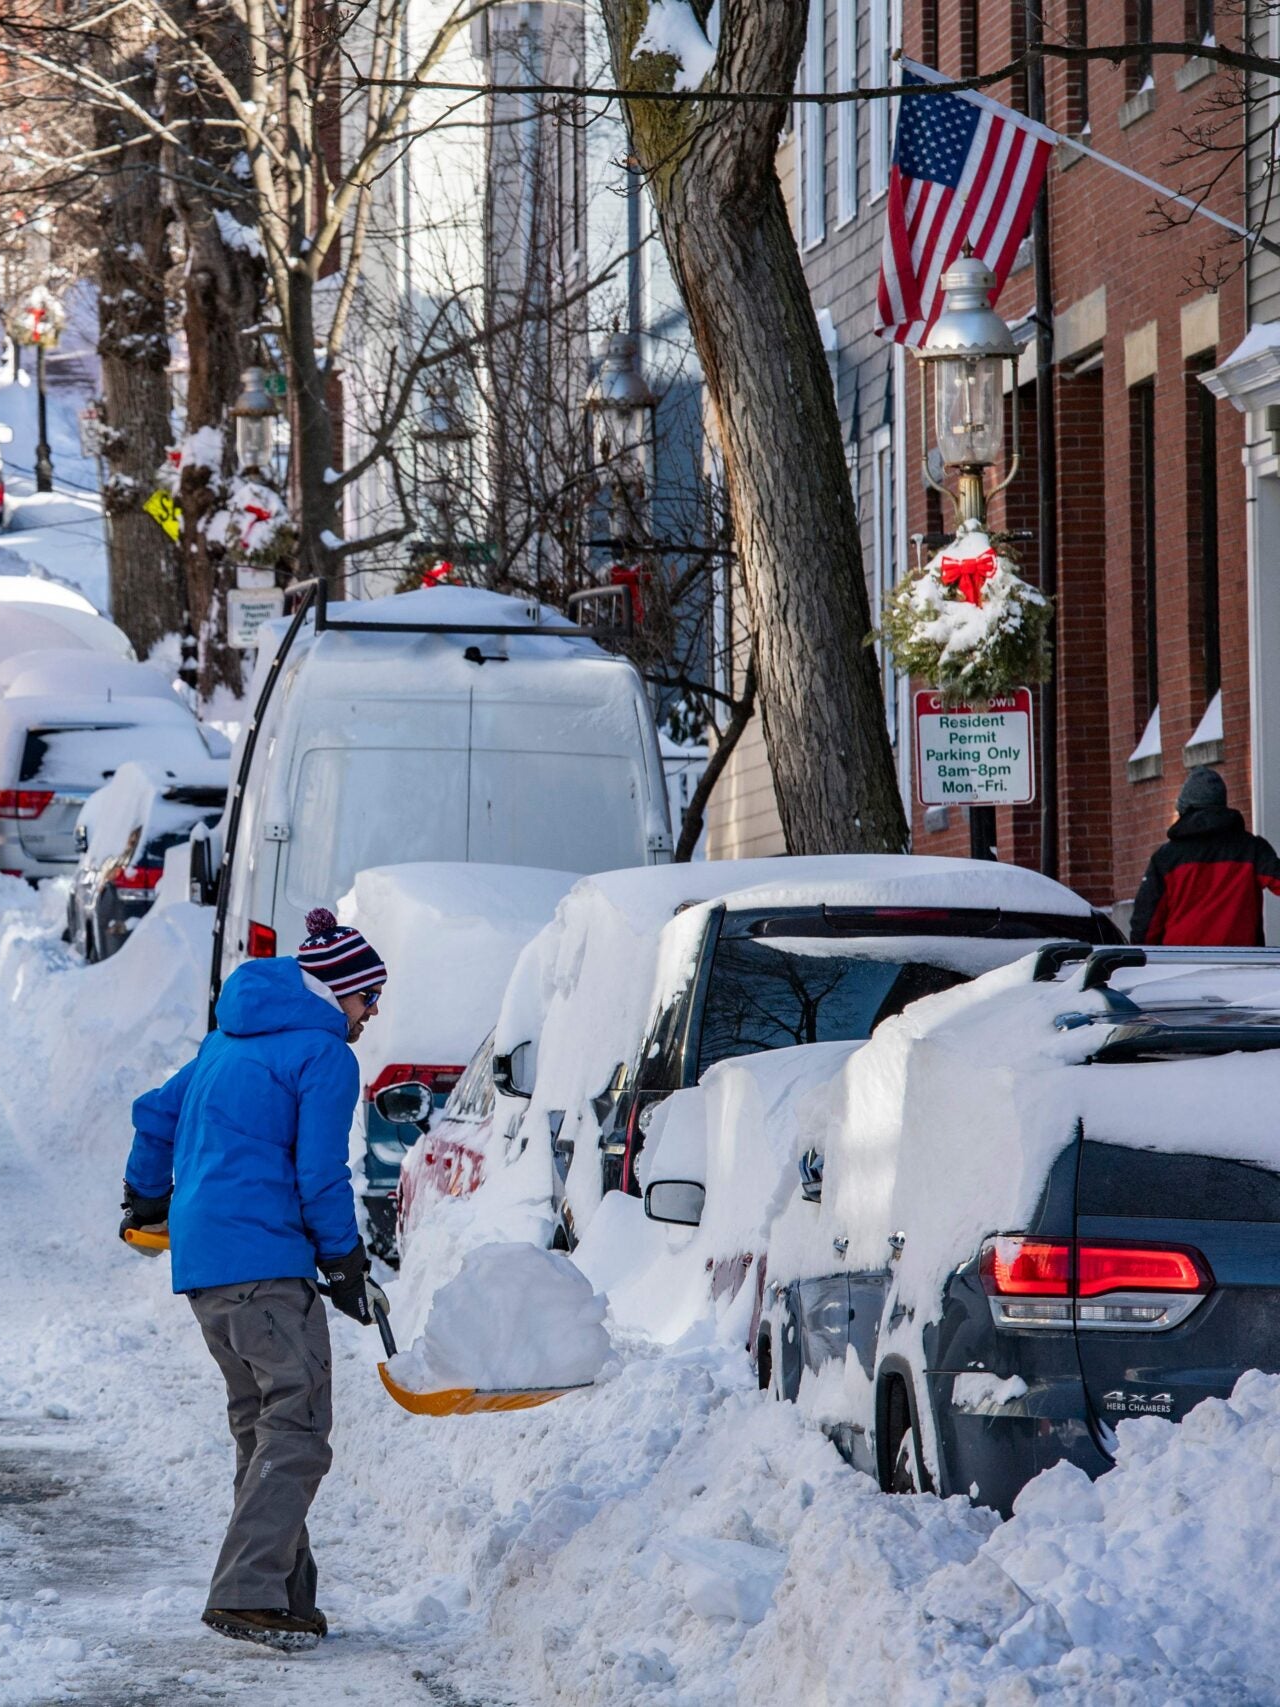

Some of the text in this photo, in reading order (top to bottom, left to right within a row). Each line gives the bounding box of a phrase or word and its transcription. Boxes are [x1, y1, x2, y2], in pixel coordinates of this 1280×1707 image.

[939, 715, 1005, 729] Resident
[949, 731, 997, 744] Permit
[926, 746, 1021, 763] Parking Only
[937, 763, 1011, 778] 8am-8pm
[942, 779, 1008, 793] Mon.-Fri.
[1106, 1402, 1171, 1413] HERB CHAMBERS
